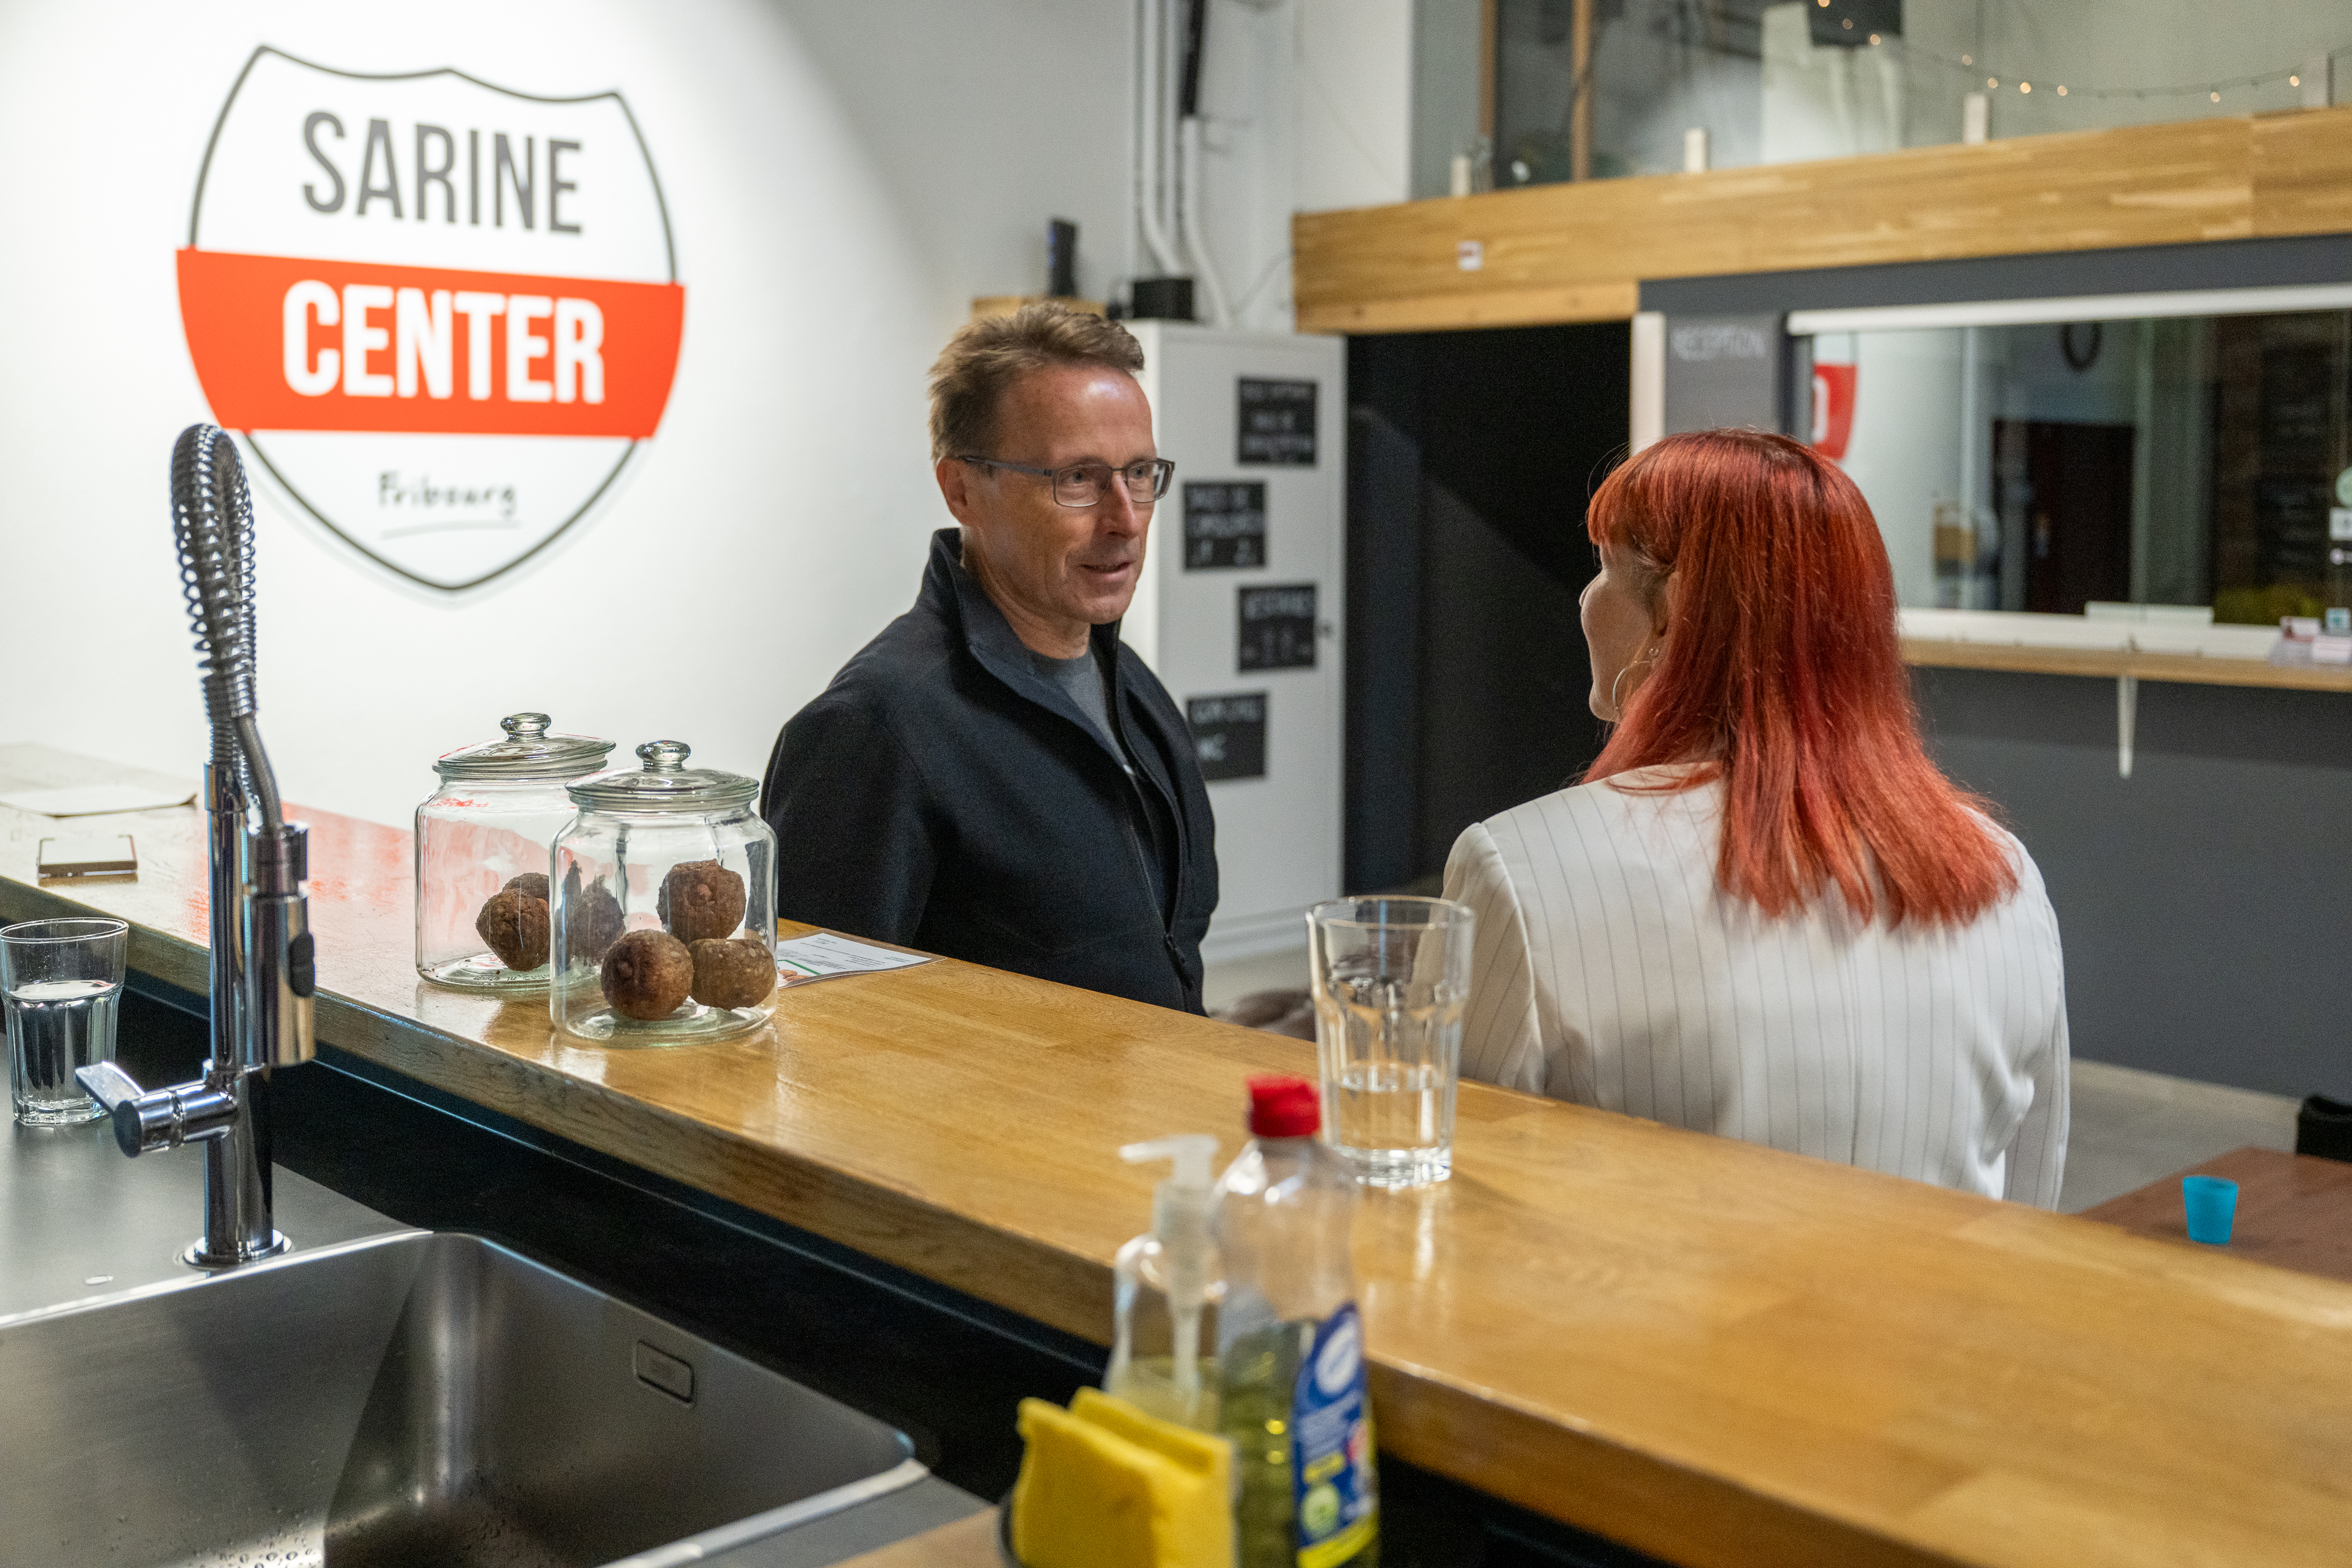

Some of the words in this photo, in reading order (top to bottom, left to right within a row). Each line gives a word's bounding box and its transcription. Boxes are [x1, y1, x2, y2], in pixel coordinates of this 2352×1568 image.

[303, 112, 582, 234] SARINE
[283, 280, 605, 404] CENTER
[379, 471, 516, 519] Fribourg
